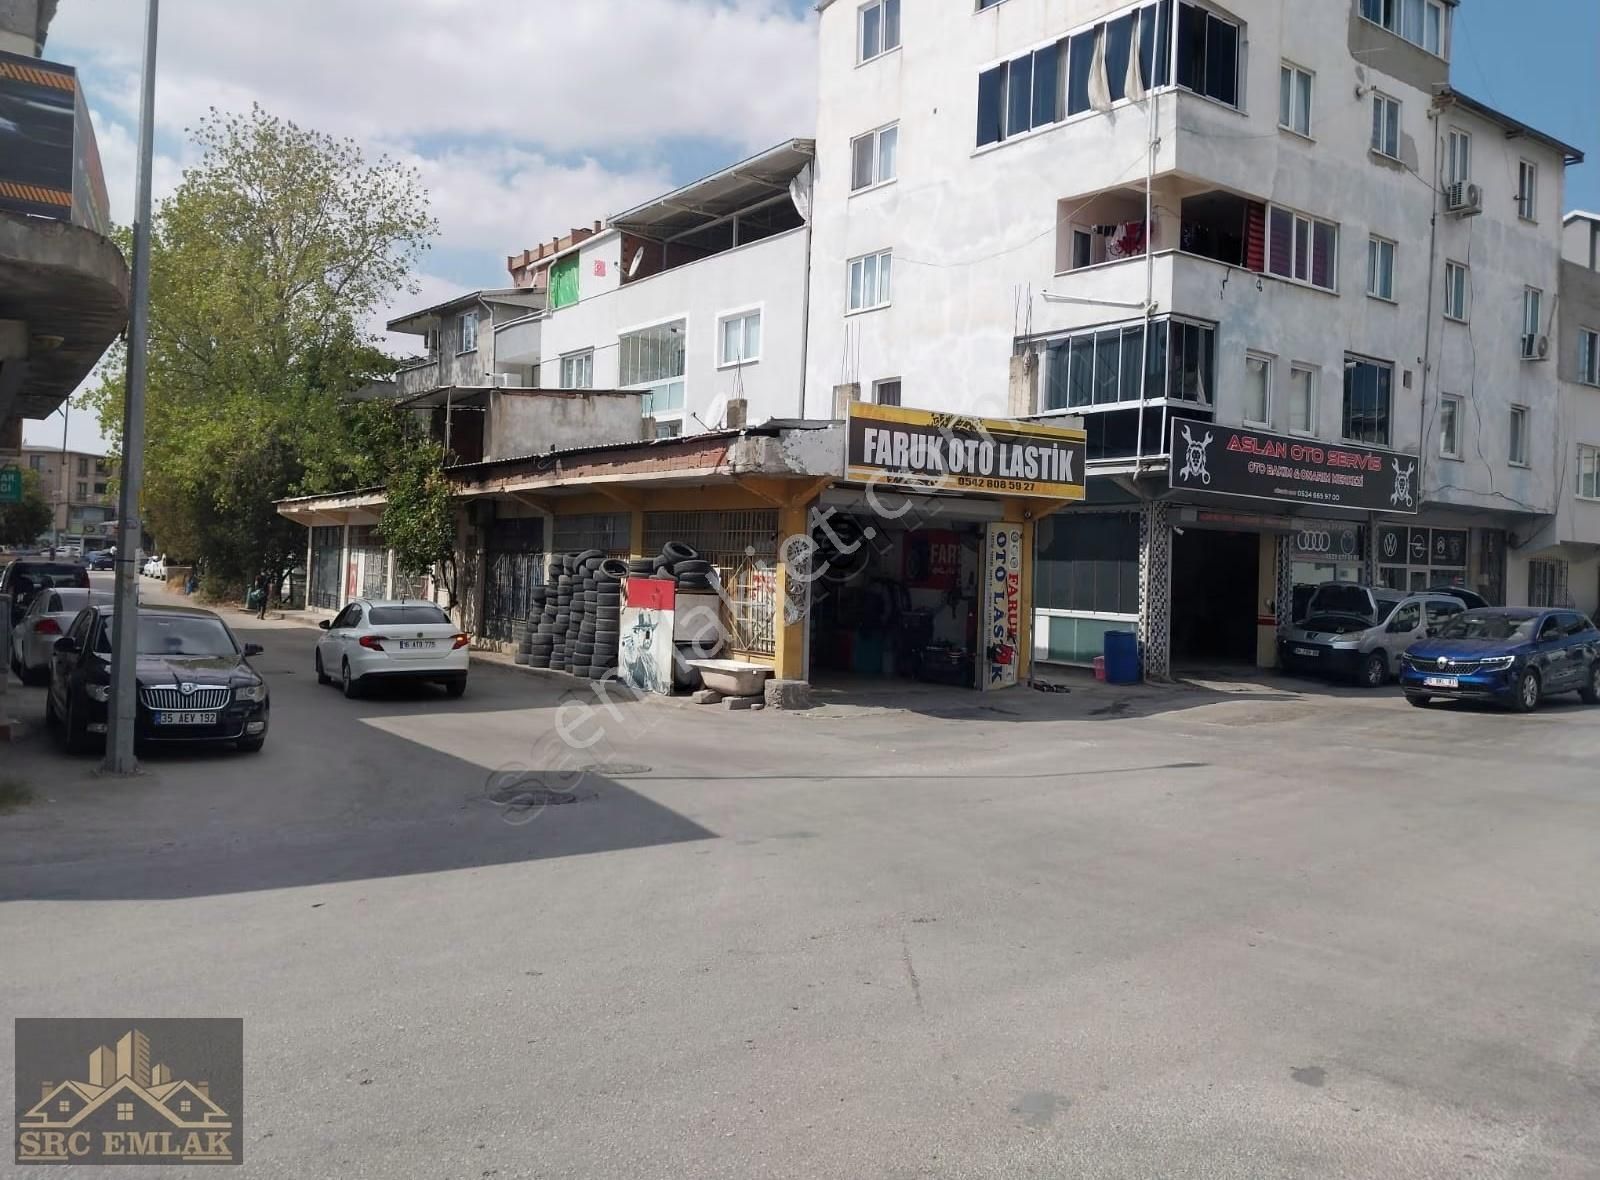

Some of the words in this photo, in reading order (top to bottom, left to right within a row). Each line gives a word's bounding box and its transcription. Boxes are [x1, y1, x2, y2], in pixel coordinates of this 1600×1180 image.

[863, 427, 944, 471] FARUK
[948, 437, 994, 476] OTO
[999, 442, 1074, 482] LASTİK
[1226, 434, 1287, 459] ASLAN
[1291, 444, 1324, 463] OTO
[1327, 450, 1382, 472] SERVİS
[1248, 461, 1266, 474] OTO
[957, 476, 984, 489] 0542
[986, 478, 1006, 490] 808
[1008, 479, 1022, 491] 59
[1023, 481, 1035, 492] 27
[931, 543, 960, 564] FAR
[995, 532, 1007, 583] OTO
[162, 713, 173, 723] 35
[178, 713, 195, 723] AEV
[200, 713, 216, 723] 192
